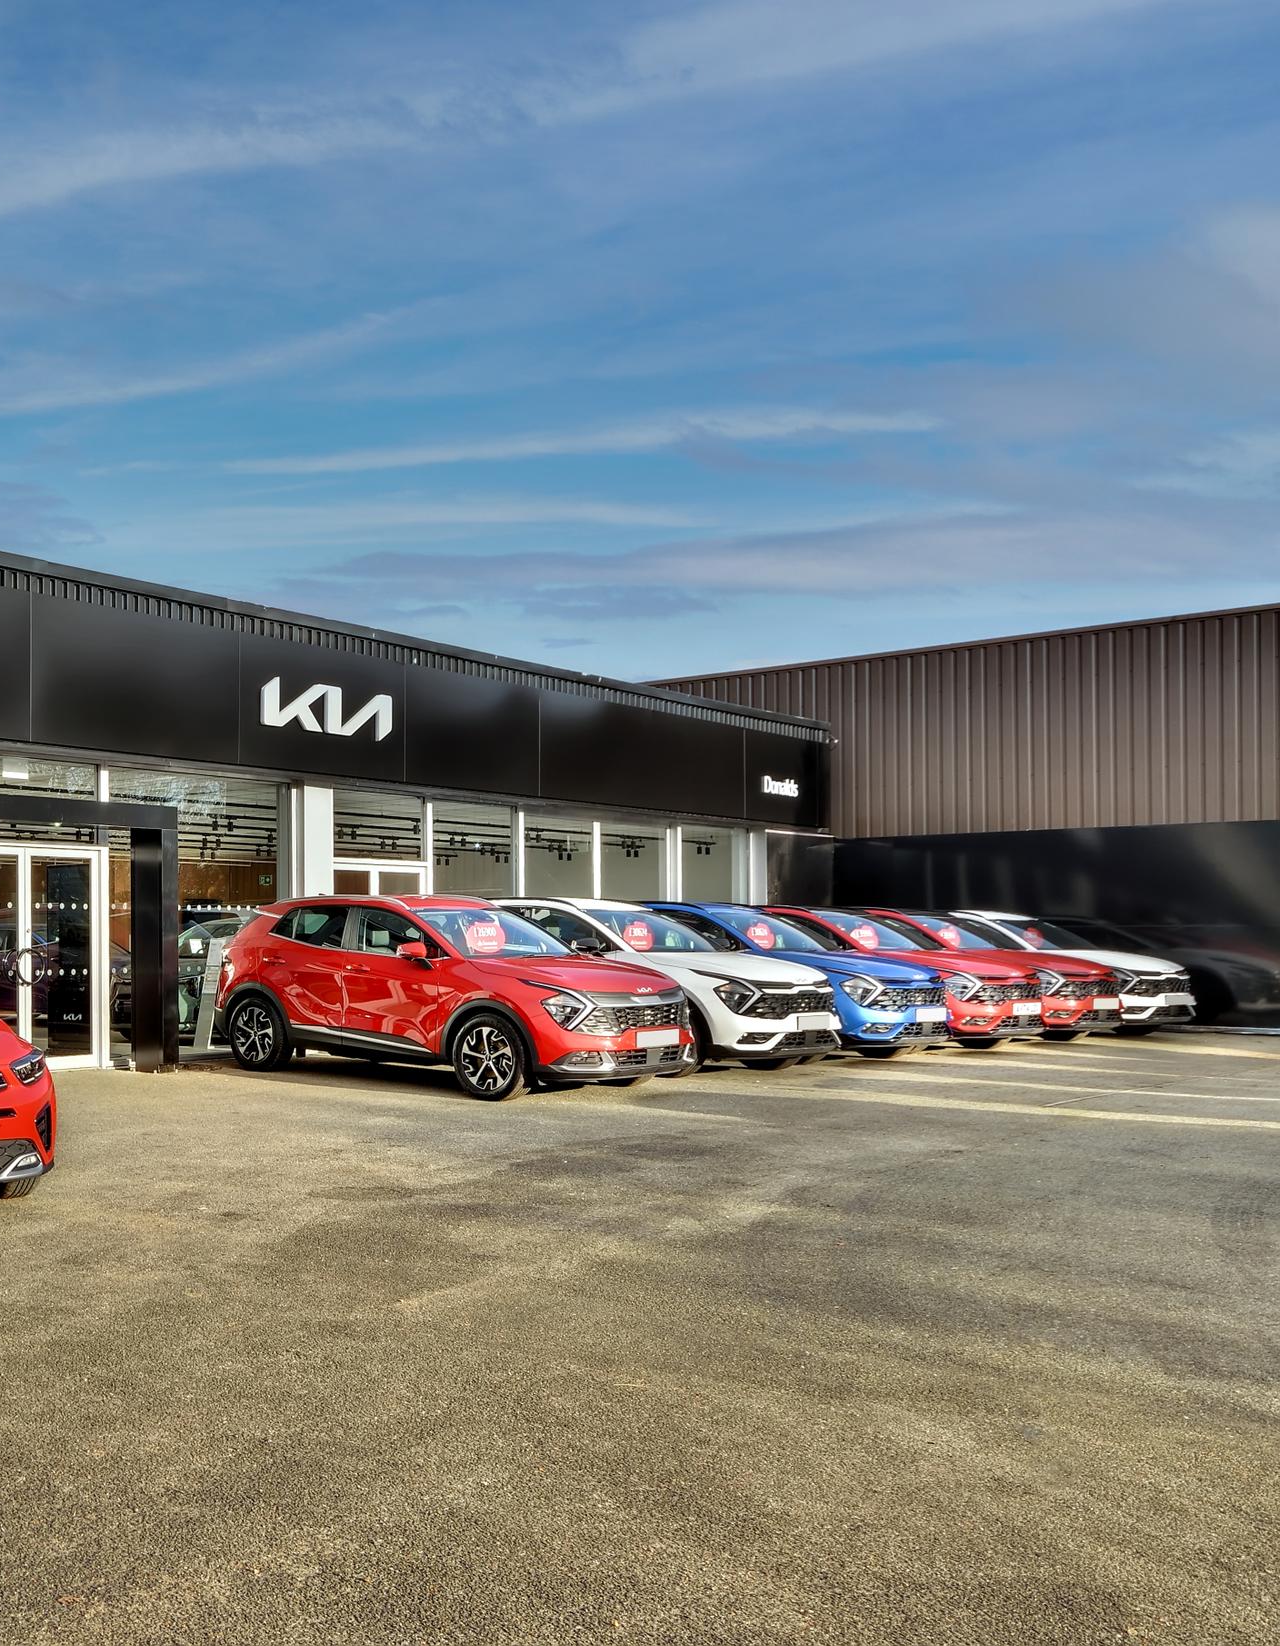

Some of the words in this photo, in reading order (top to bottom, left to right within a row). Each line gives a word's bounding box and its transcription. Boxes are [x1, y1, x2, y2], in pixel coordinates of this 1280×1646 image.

[260, 676, 393, 741] KIA
[761, 775, 799, 798] Donalds
[63, 1013, 83, 1021] KIA
